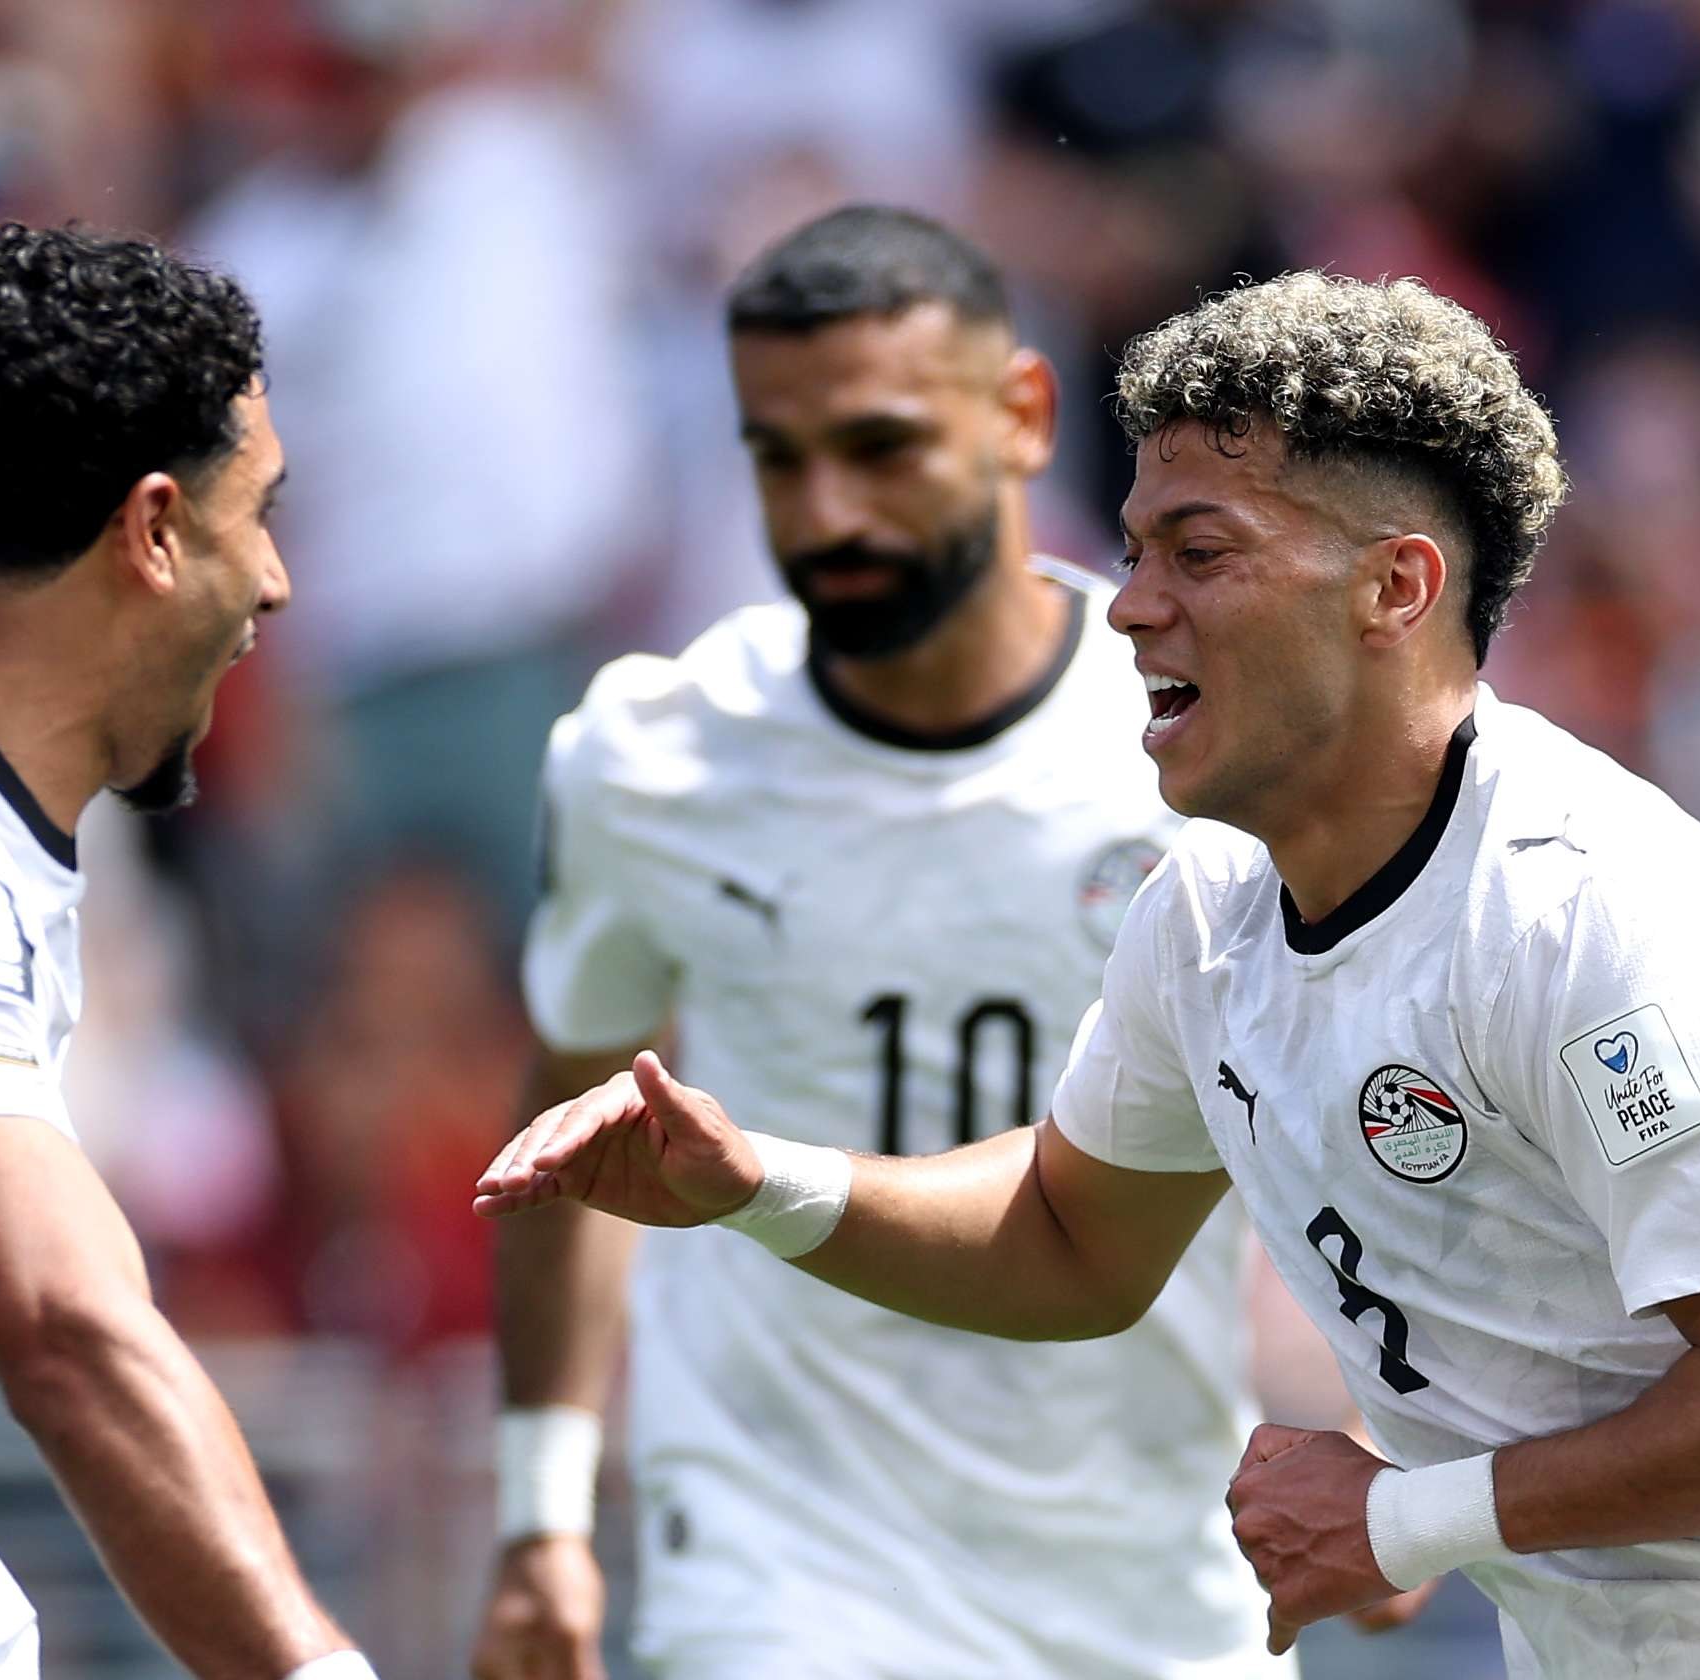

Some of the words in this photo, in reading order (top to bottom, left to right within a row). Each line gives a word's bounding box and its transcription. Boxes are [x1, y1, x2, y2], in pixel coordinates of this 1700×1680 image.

[1604, 1078, 1642, 1110] Unite
[1639, 1064, 1664, 1092] For
[1616, 1088, 1676, 1132] PEACE
[1638, 1119, 1670, 1142] FIFA
[1401, 1160, 1440, 1172] EGYPTIAN
